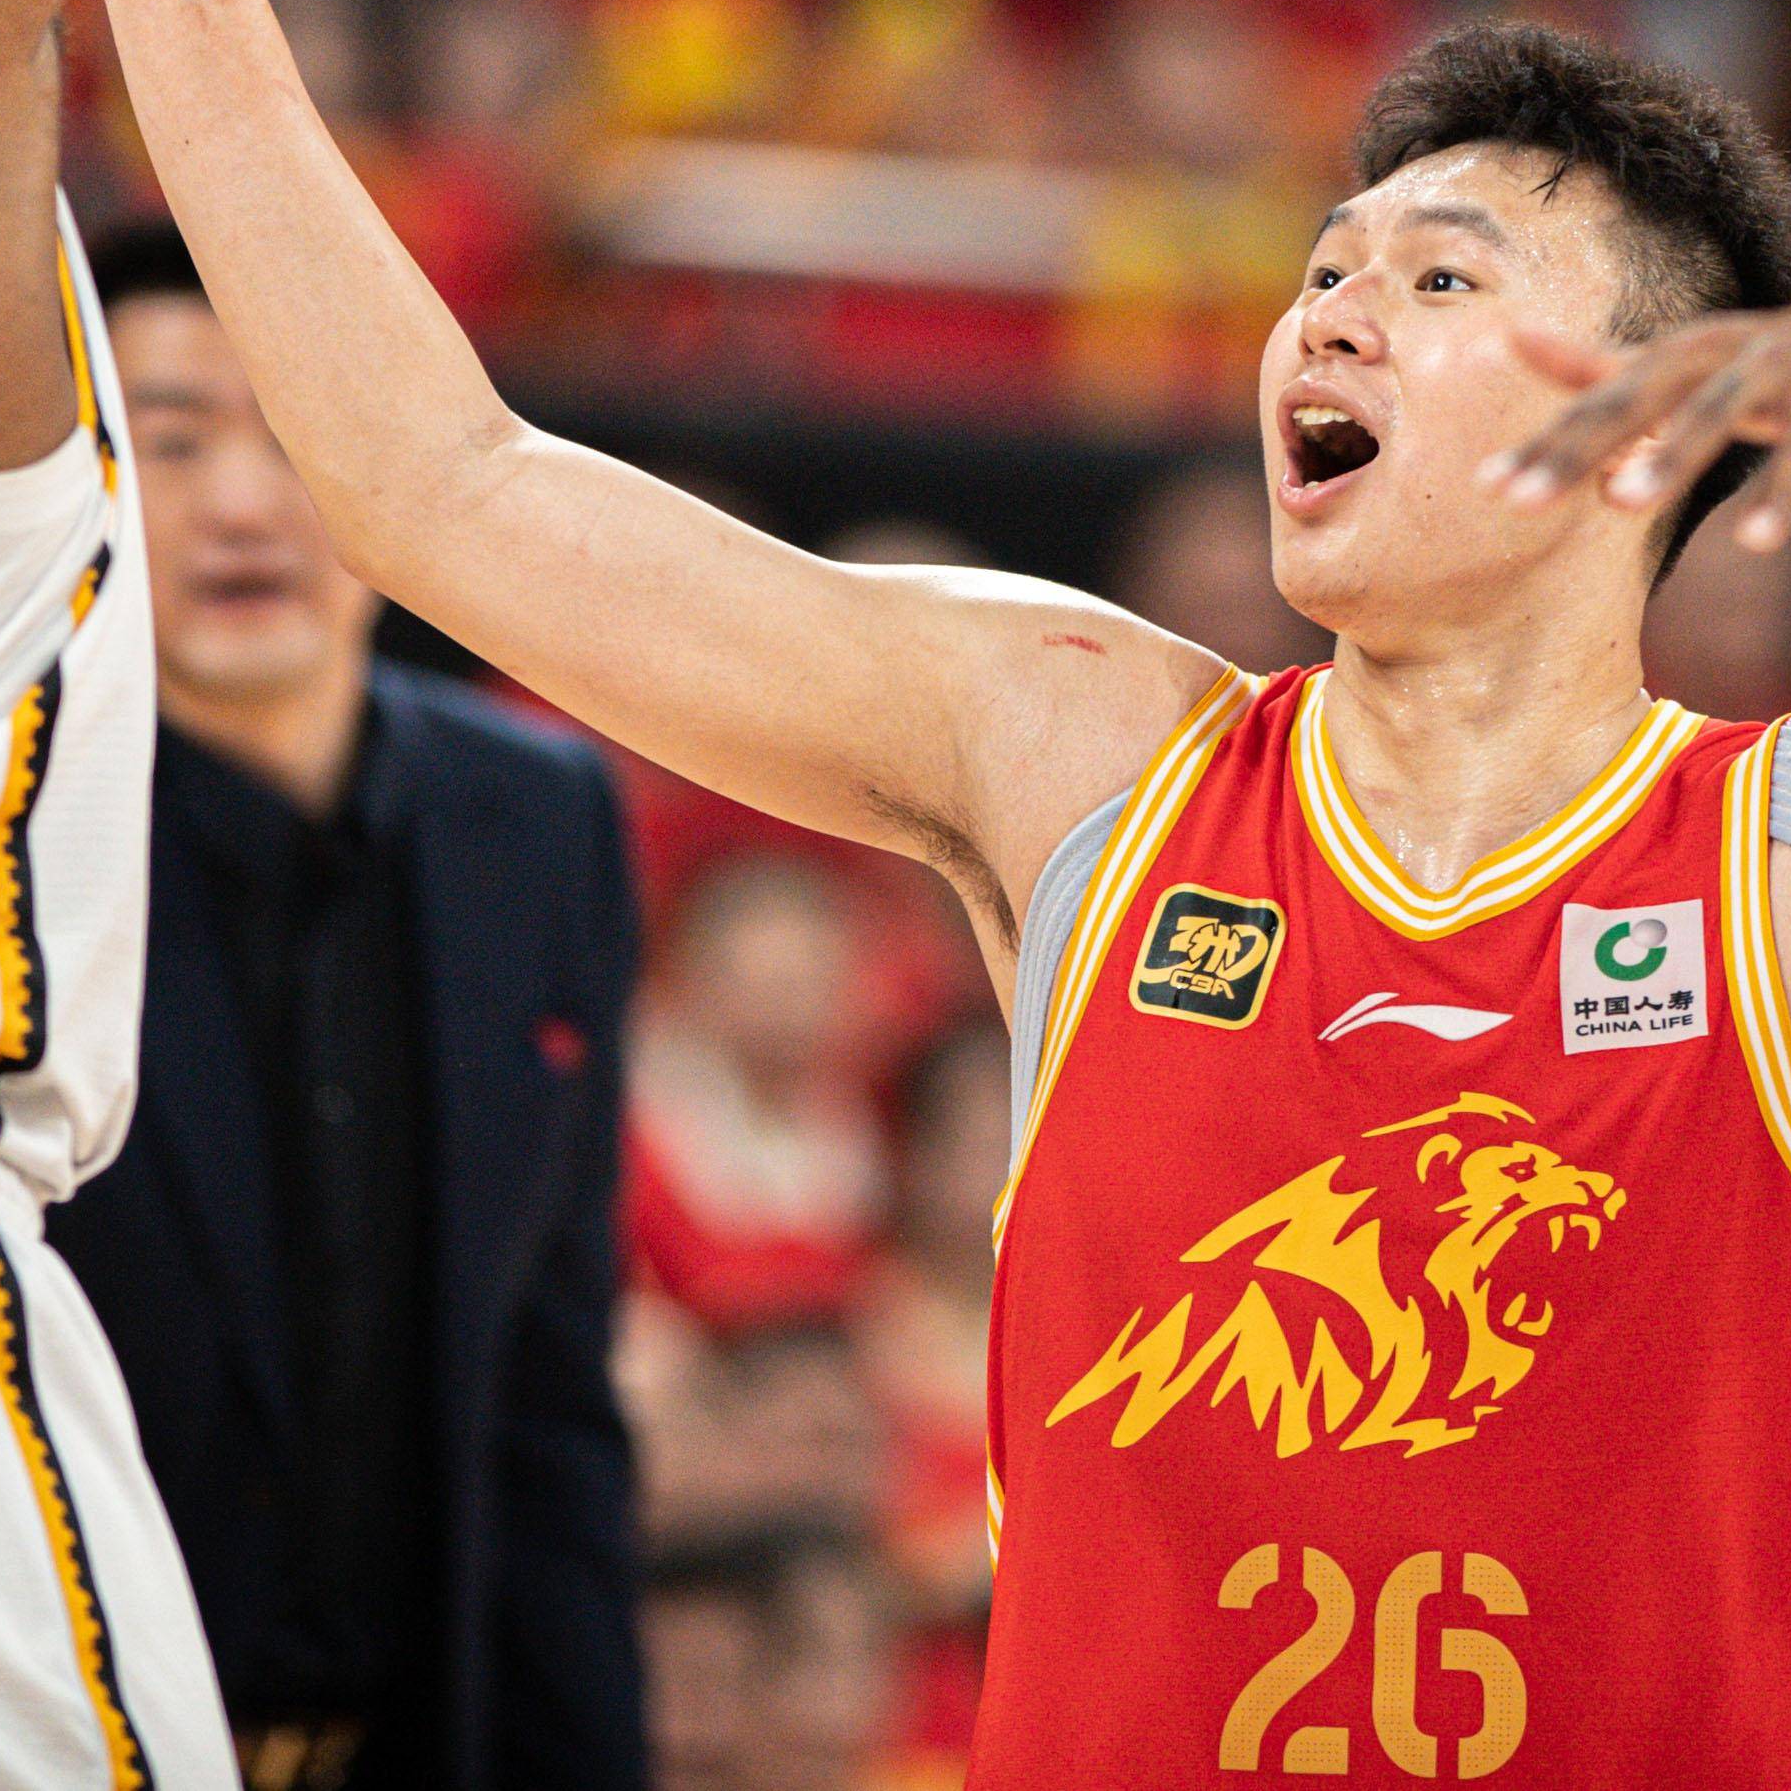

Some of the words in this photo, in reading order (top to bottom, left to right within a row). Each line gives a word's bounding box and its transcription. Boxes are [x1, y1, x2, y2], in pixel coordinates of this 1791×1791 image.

[1573, 989, 1695, 1020] 中国人寿
[1575, 1021, 1643, 1037] CHINA
[1649, 1013, 1694, 1031] LIFE
[1217, 1542, 1530, 1780] 26
